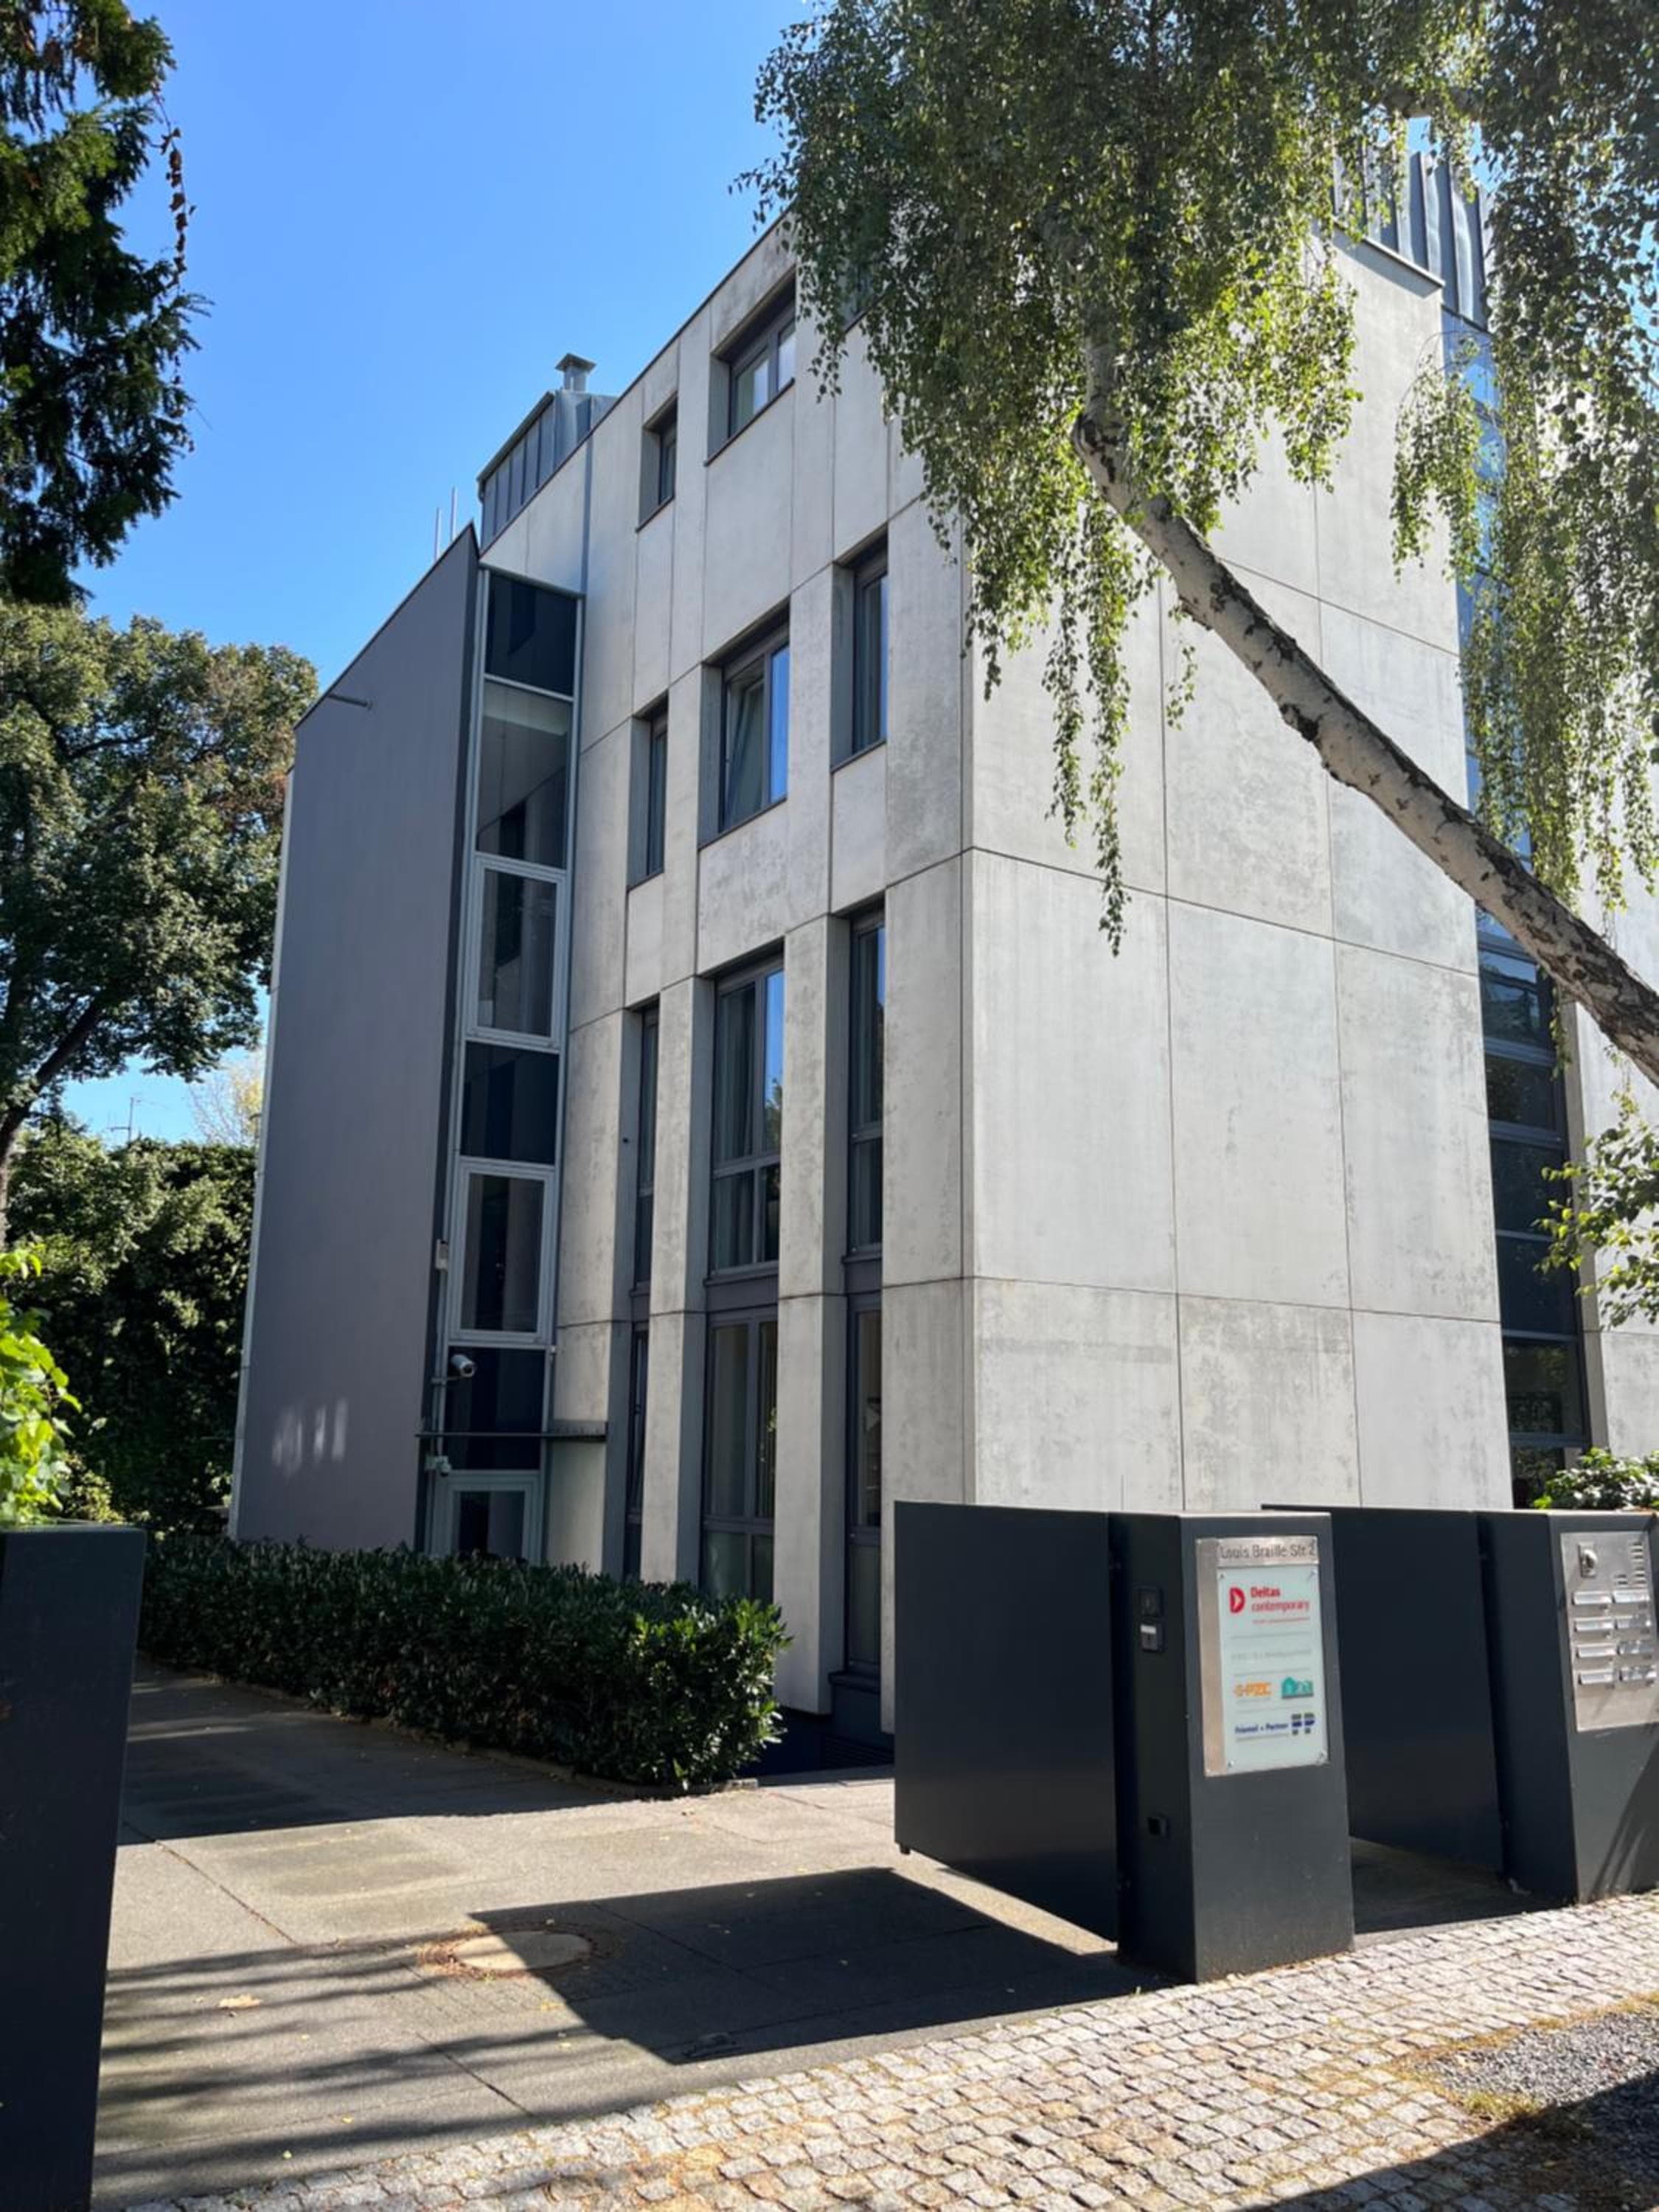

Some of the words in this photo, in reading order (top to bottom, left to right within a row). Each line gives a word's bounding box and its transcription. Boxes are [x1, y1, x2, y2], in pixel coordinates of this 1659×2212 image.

[1220, 1545, 1250, 1559] Louis
[1252, 1543, 1287, 1558] Braille
[1251, 1601, 1310, 1614] contemporary
